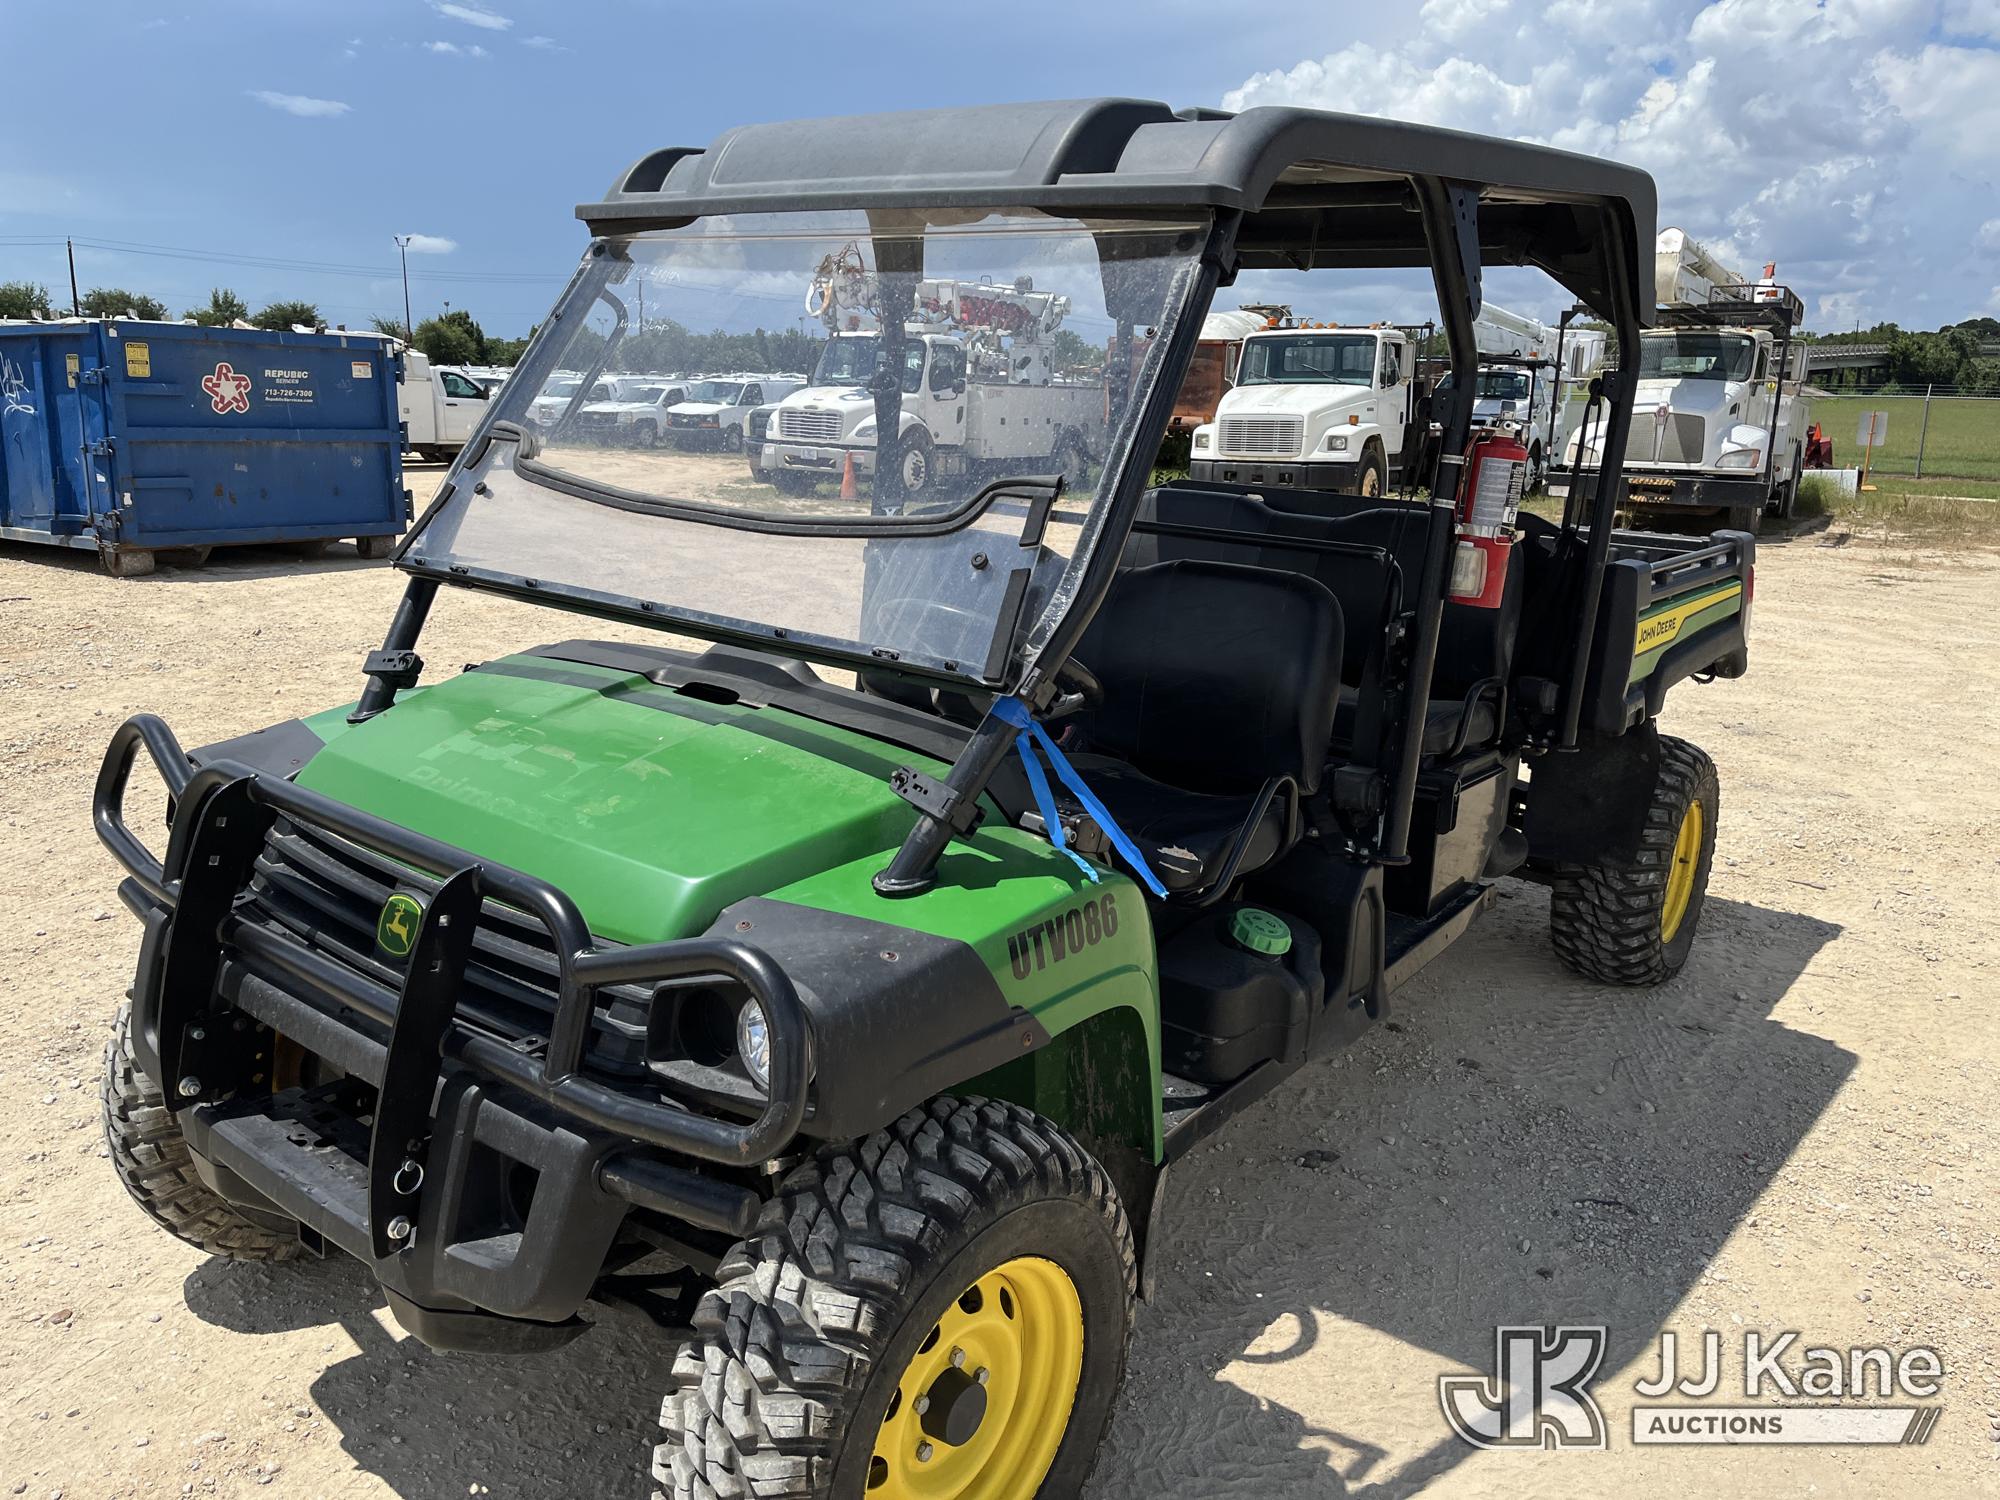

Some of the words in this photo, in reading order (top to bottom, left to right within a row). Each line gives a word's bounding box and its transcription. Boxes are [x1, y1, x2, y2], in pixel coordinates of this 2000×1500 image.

[264, 369, 309, 379] REPUBLIC
[264, 388, 313, 397] 713-726-7300
[1638, 625, 1657, 645] JOHN
[1656, 618, 1677, 637] DEERE
